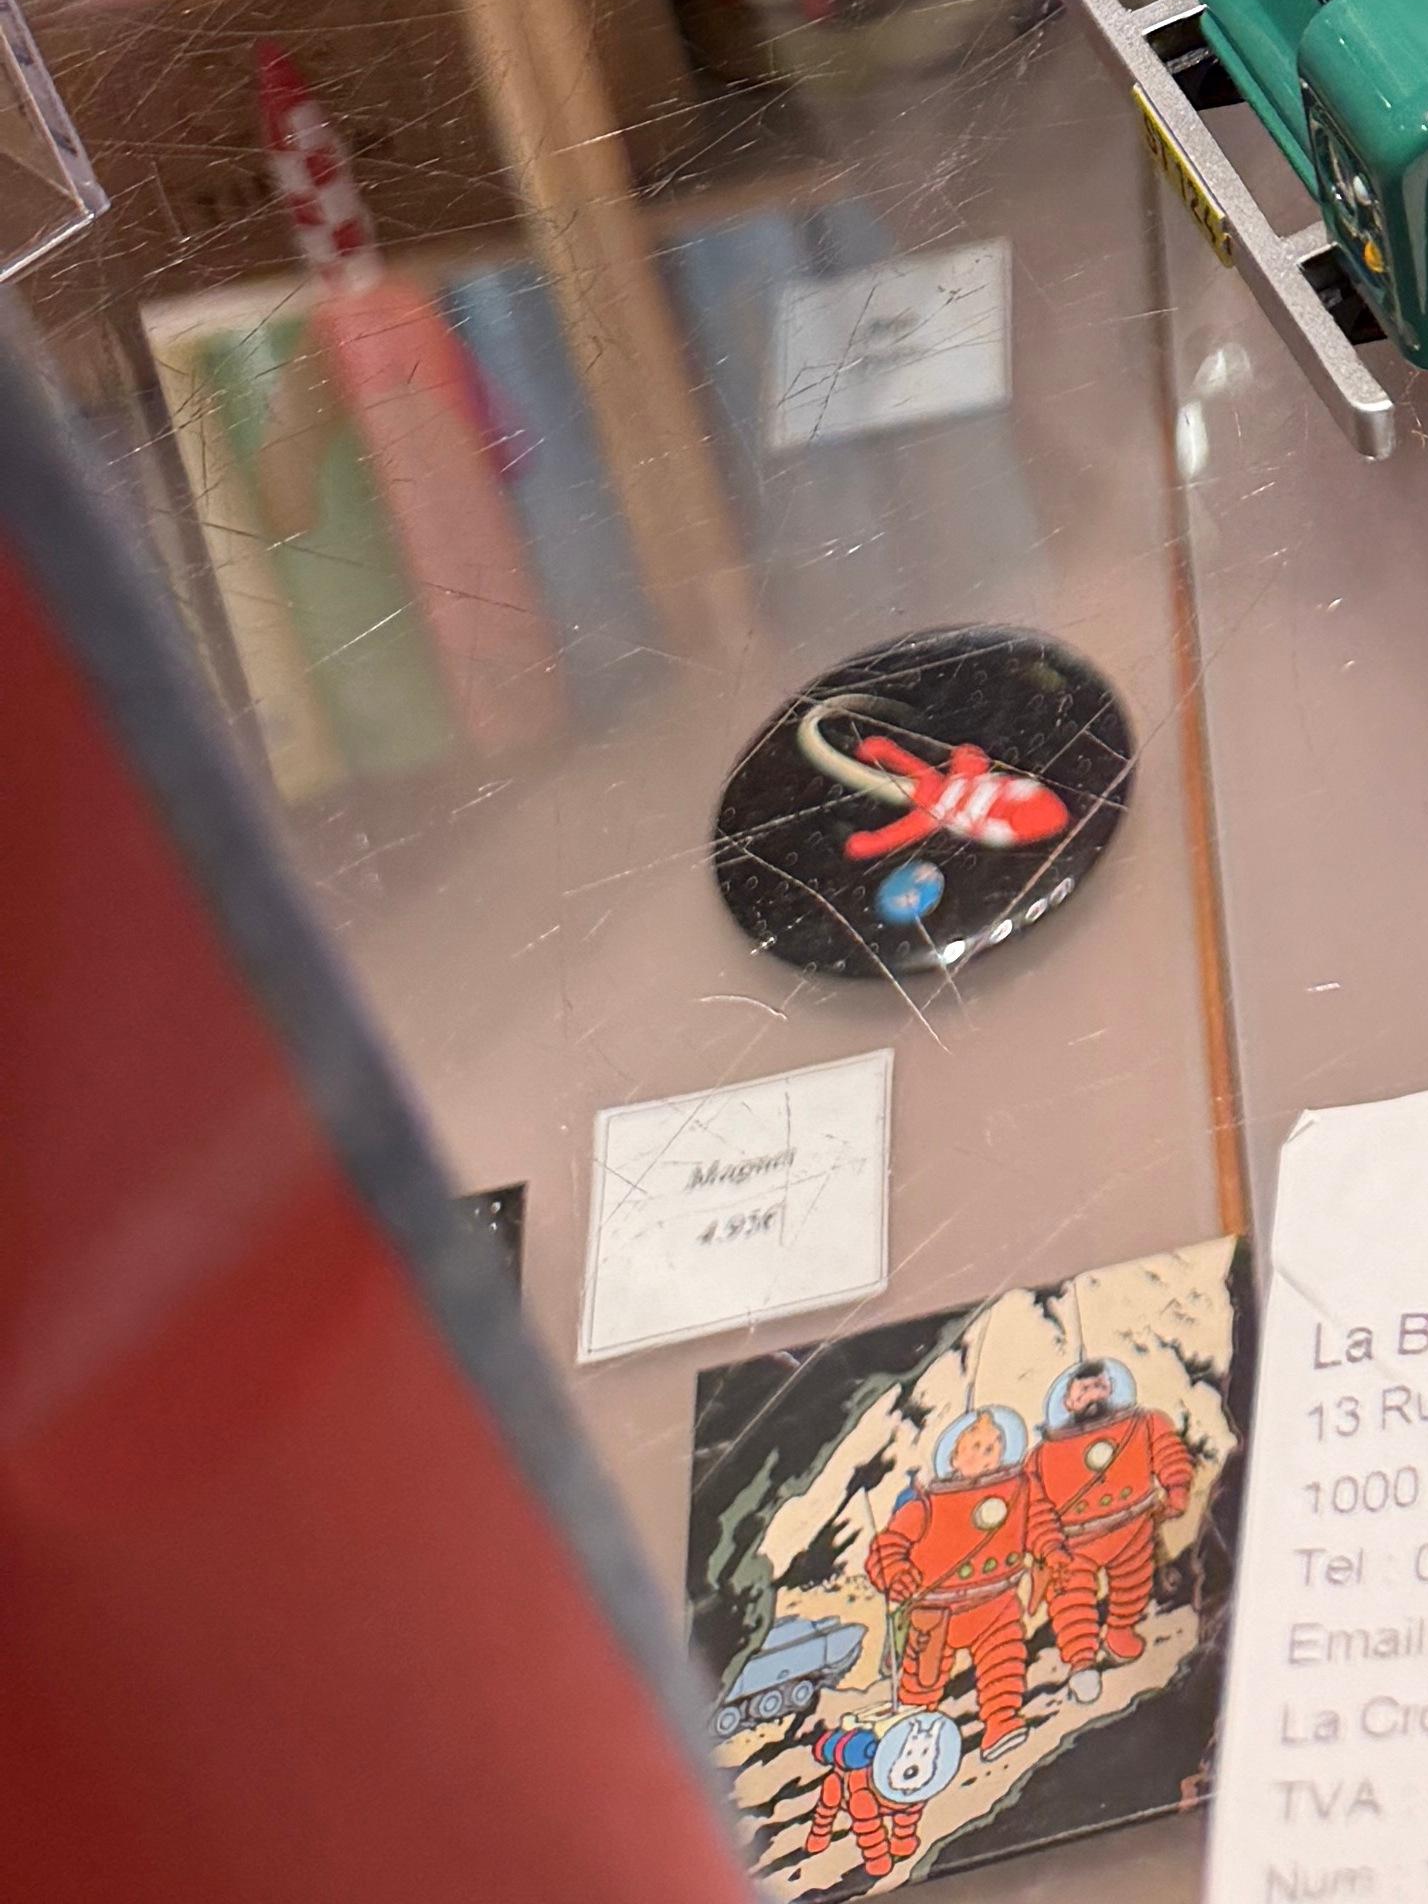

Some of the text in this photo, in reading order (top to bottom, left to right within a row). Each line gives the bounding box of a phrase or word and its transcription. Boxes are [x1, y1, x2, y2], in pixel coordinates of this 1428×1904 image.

[1313, 1322, 1374, 1370] La
[1306, 1395, 1362, 1442] 13
[1302, 1466, 1421, 1515] 1000
[1294, 1547, 1365, 1587] Tel
[1286, 1616, 1425, 1667] Email
[1280, 1700, 1341, 1746] La
[1275, 1779, 1383, 1822] TVA
